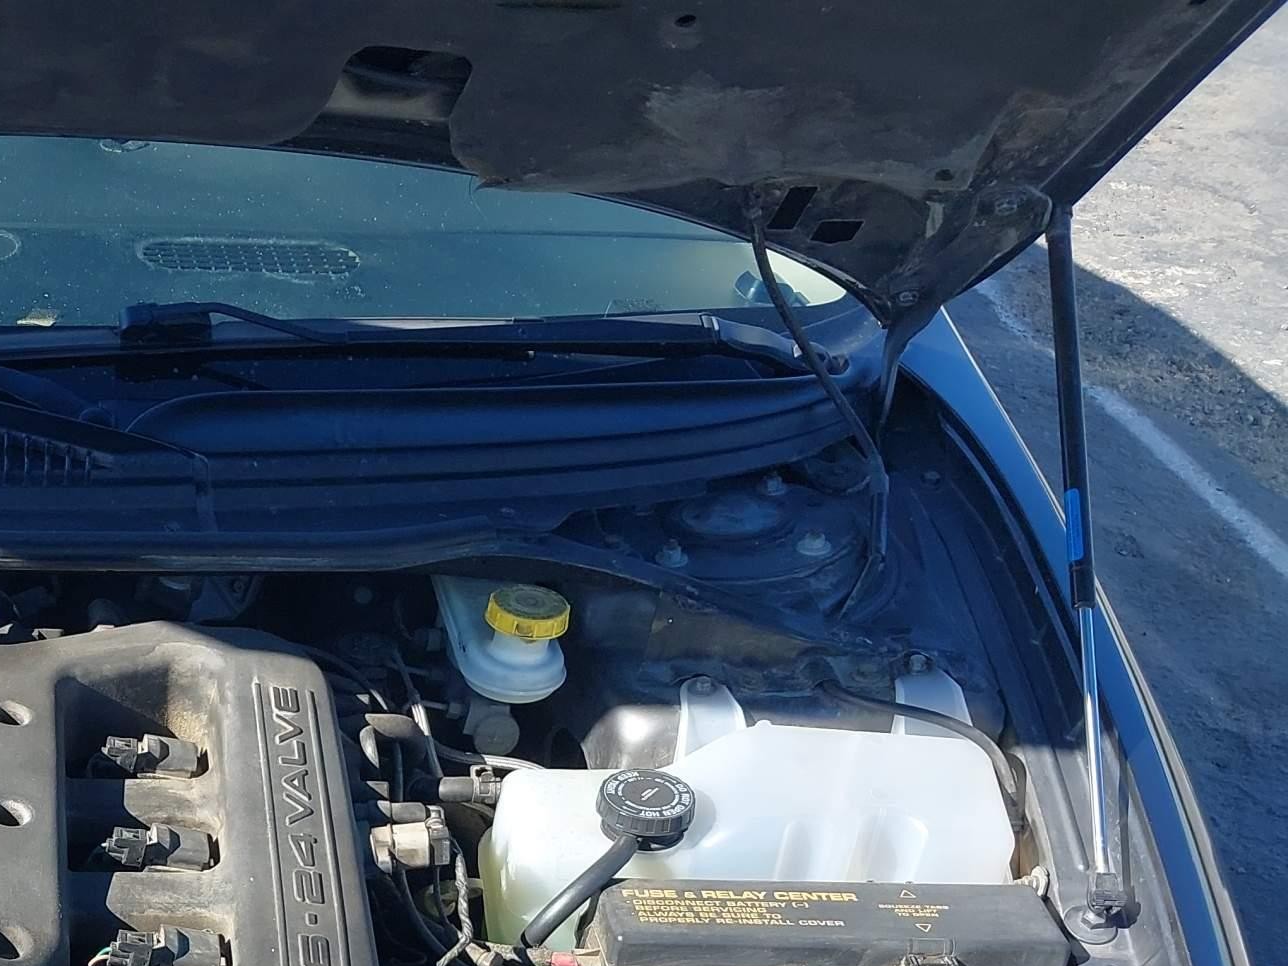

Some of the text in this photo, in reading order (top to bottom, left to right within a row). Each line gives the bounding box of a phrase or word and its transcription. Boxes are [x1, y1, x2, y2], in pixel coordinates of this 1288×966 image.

[675, 783, 688, 793] DO
[640, 810, 660, 818] HOT
[661, 805, 685, 817] OPEN
[621, 889, 859, 902] FUSE & RELAY CENTER
[726, 900, 787, 908] BATTERY
[639, 916, 845, 927] PROPERLY RE-INSTALL COVER
